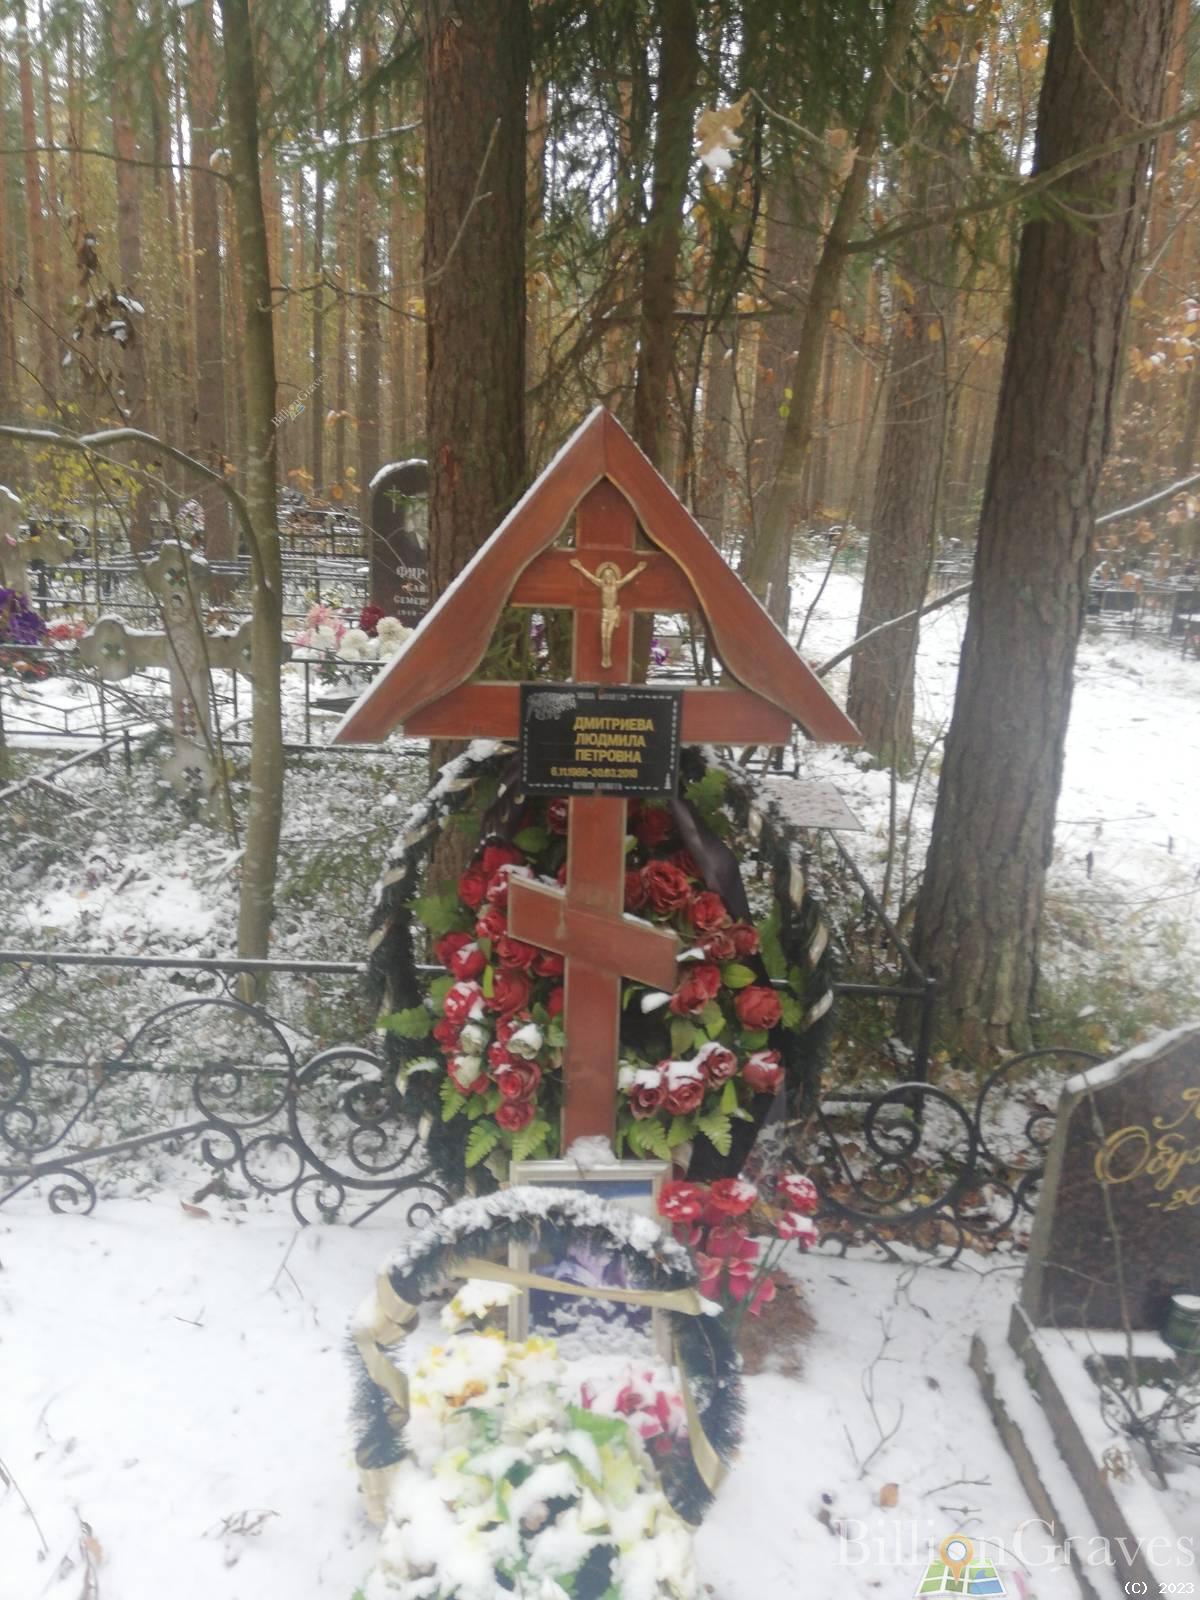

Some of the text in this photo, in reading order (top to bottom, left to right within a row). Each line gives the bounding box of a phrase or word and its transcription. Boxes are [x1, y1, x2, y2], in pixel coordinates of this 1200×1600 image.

[572, 716, 654, 732] ДМИТРИЕВА
[574, 733, 646, 748] ЛЮДМИЛА
[575, 749, 642, 763] ПЕТРОВНА
